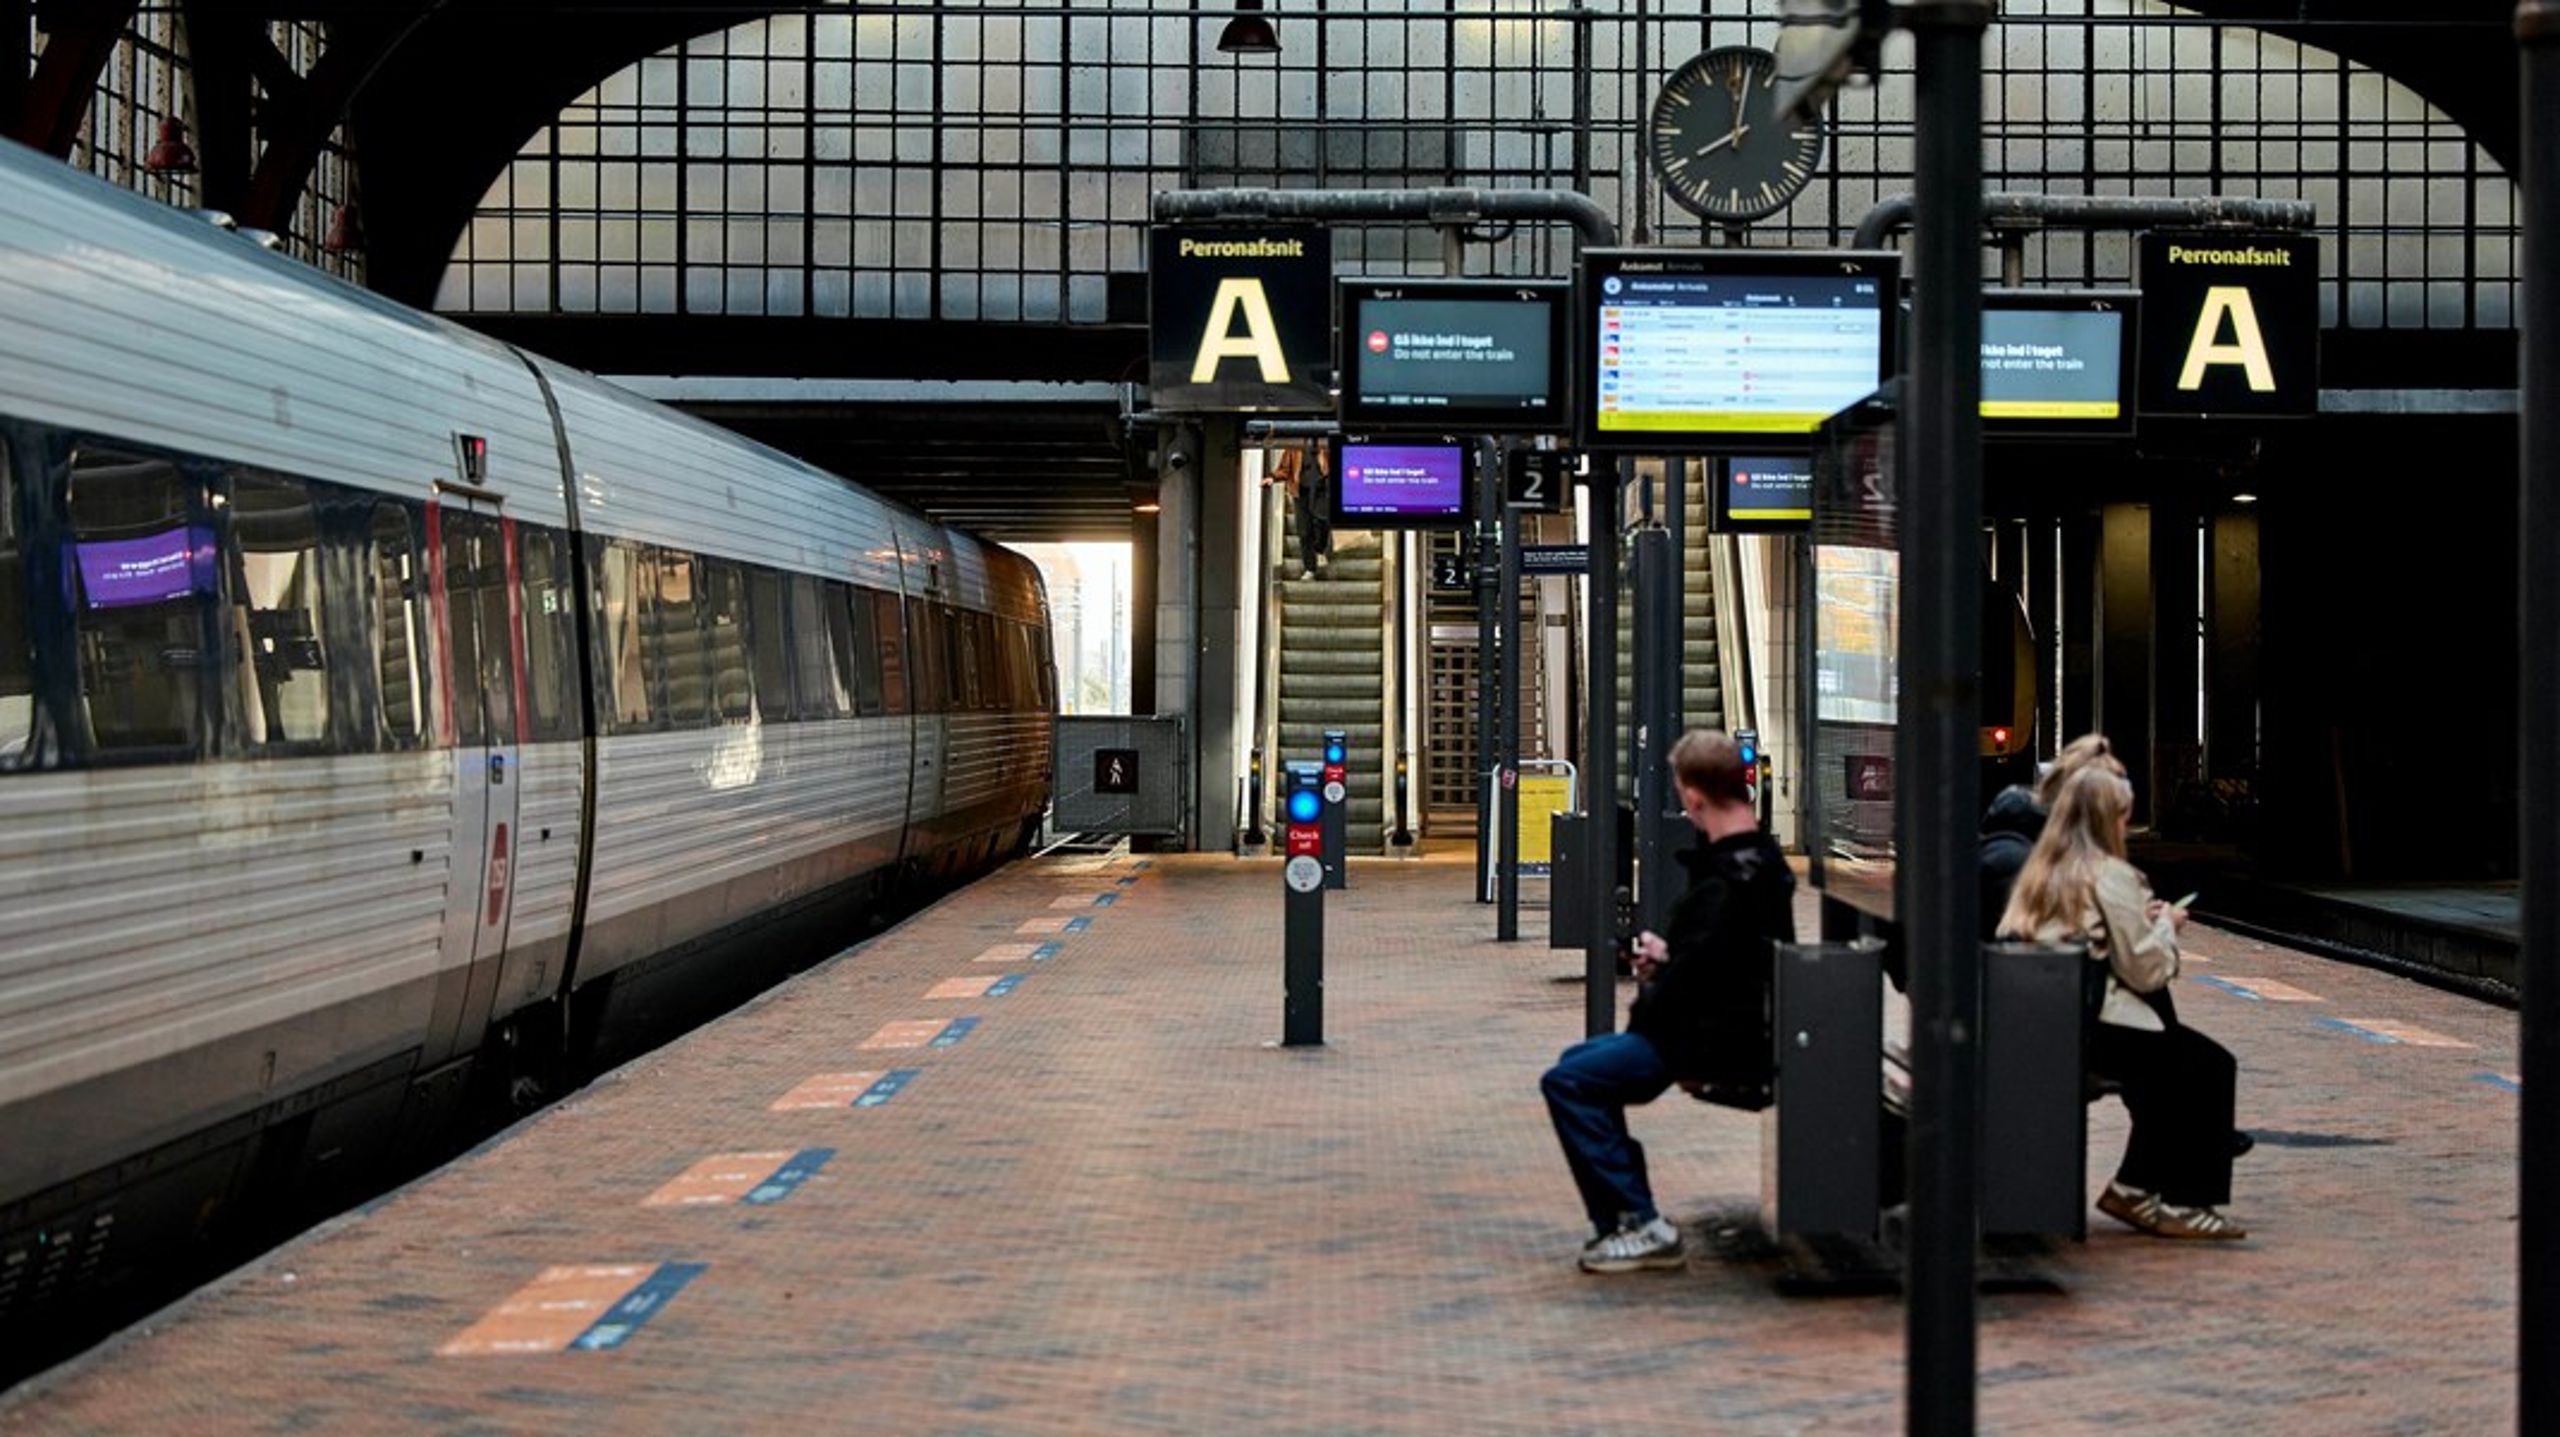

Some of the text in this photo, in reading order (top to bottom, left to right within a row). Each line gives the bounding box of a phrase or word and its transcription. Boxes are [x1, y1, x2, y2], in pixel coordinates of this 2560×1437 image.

[1179, 238, 1304, 257] Perronafsnit
[2168, 245, 2291, 266] Perronafsnit
[1190, 278, 1291, 383] A
[1462, 335, 1493, 349] toget
[2177, 286, 2277, 392] A
[1394, 349, 1514, 360] Do not enter the train
[2032, 345, 2063, 359] toget
[2003, 359, 2033, 370] enter
[2035, 359, 2054, 370] the
[2056, 359, 2084, 370] train
[1523, 471, 1543, 498] 2
[1444, 568, 1457, 584] 2
[1289, 829, 1319, 840] Check
